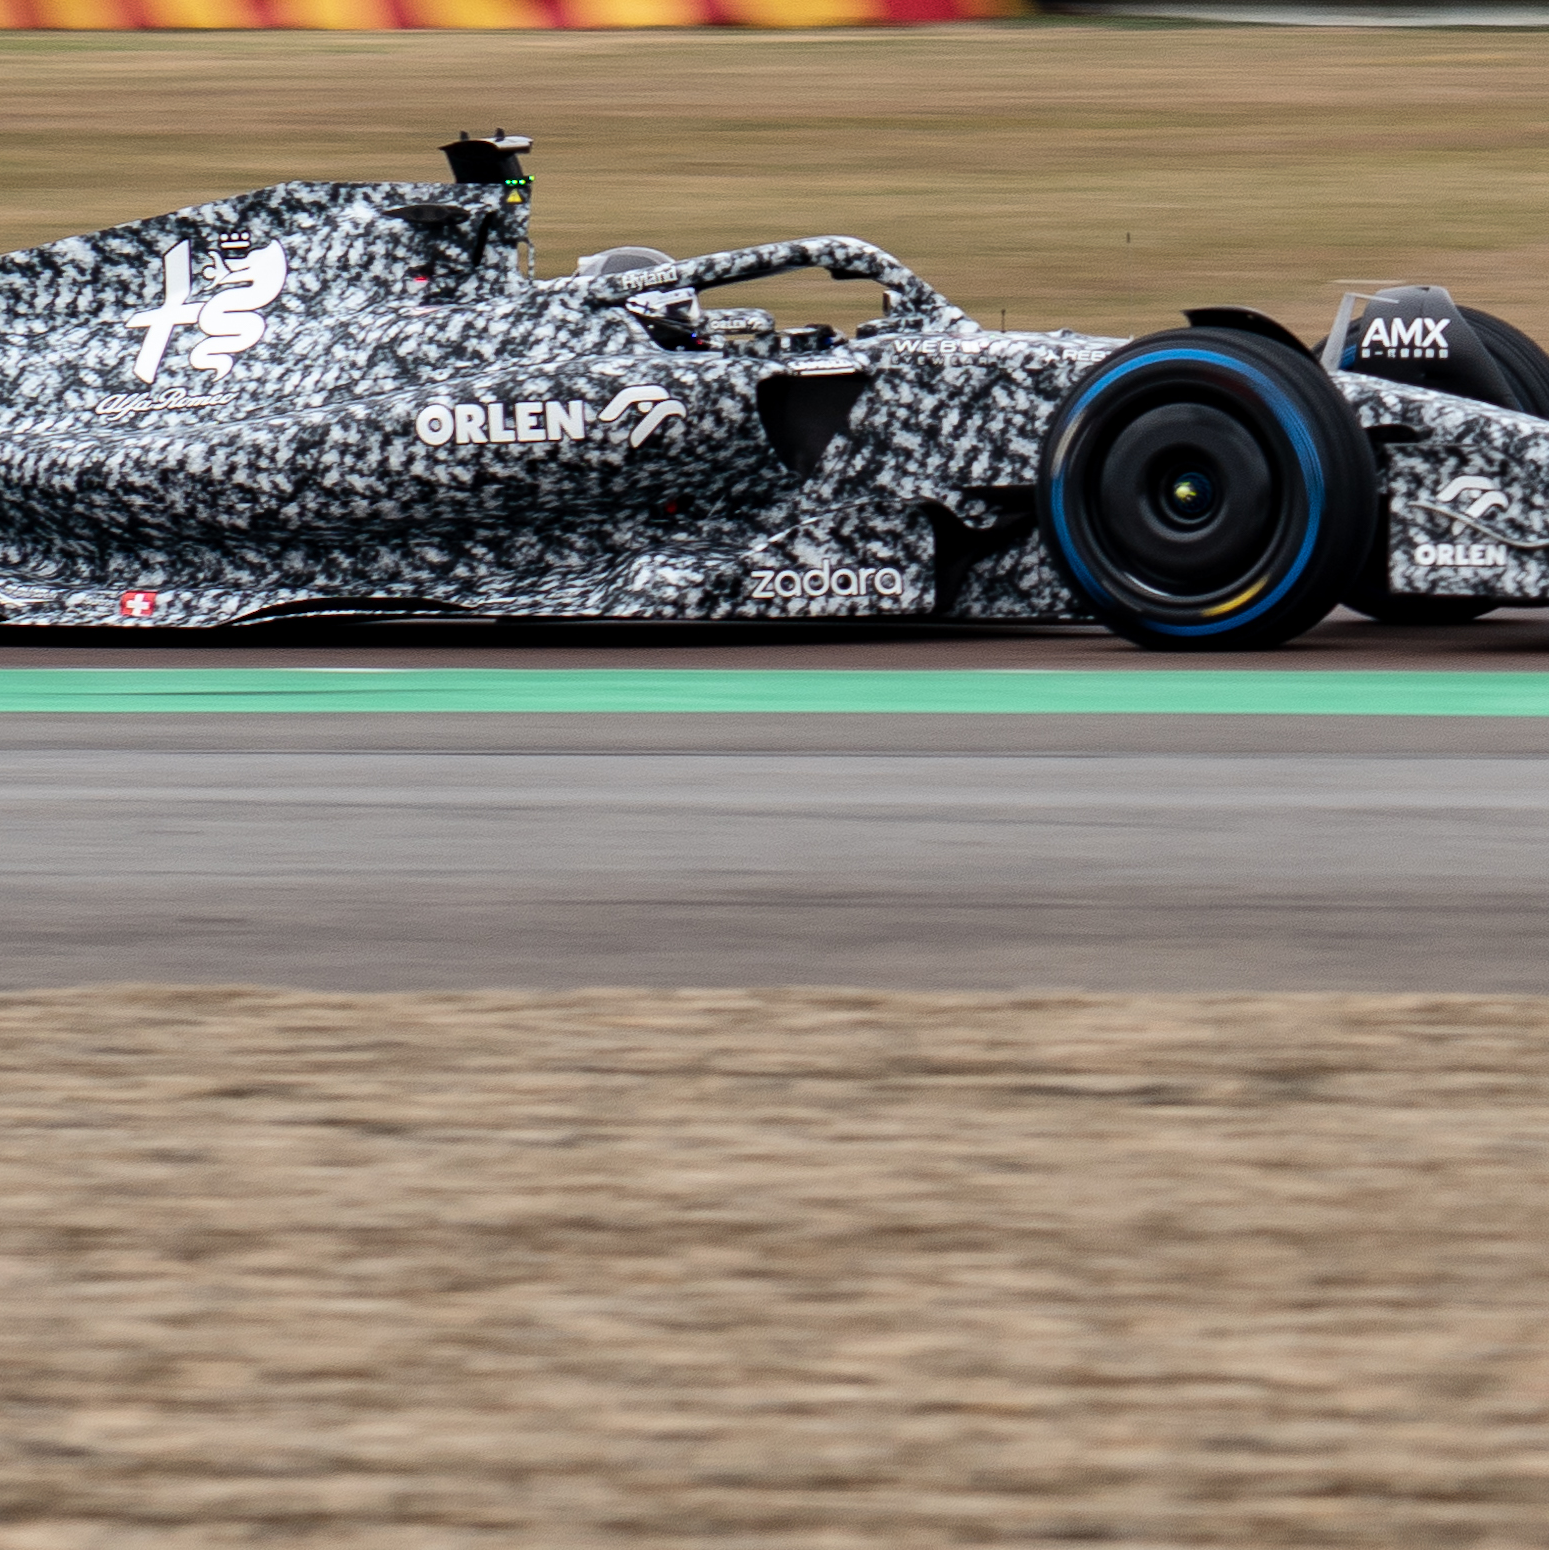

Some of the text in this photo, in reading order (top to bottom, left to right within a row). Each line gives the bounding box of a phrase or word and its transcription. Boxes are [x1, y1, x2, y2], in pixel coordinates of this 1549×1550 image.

[621, 266, 678, 290] Hyland
[1361, 317, 1451, 348] AMX
[894, 339, 957, 354] WEB
[415, 399, 586, 447] ORLEN
[1414, 543, 1507, 566] ORLEN
[751, 558, 903, 599] zadara
